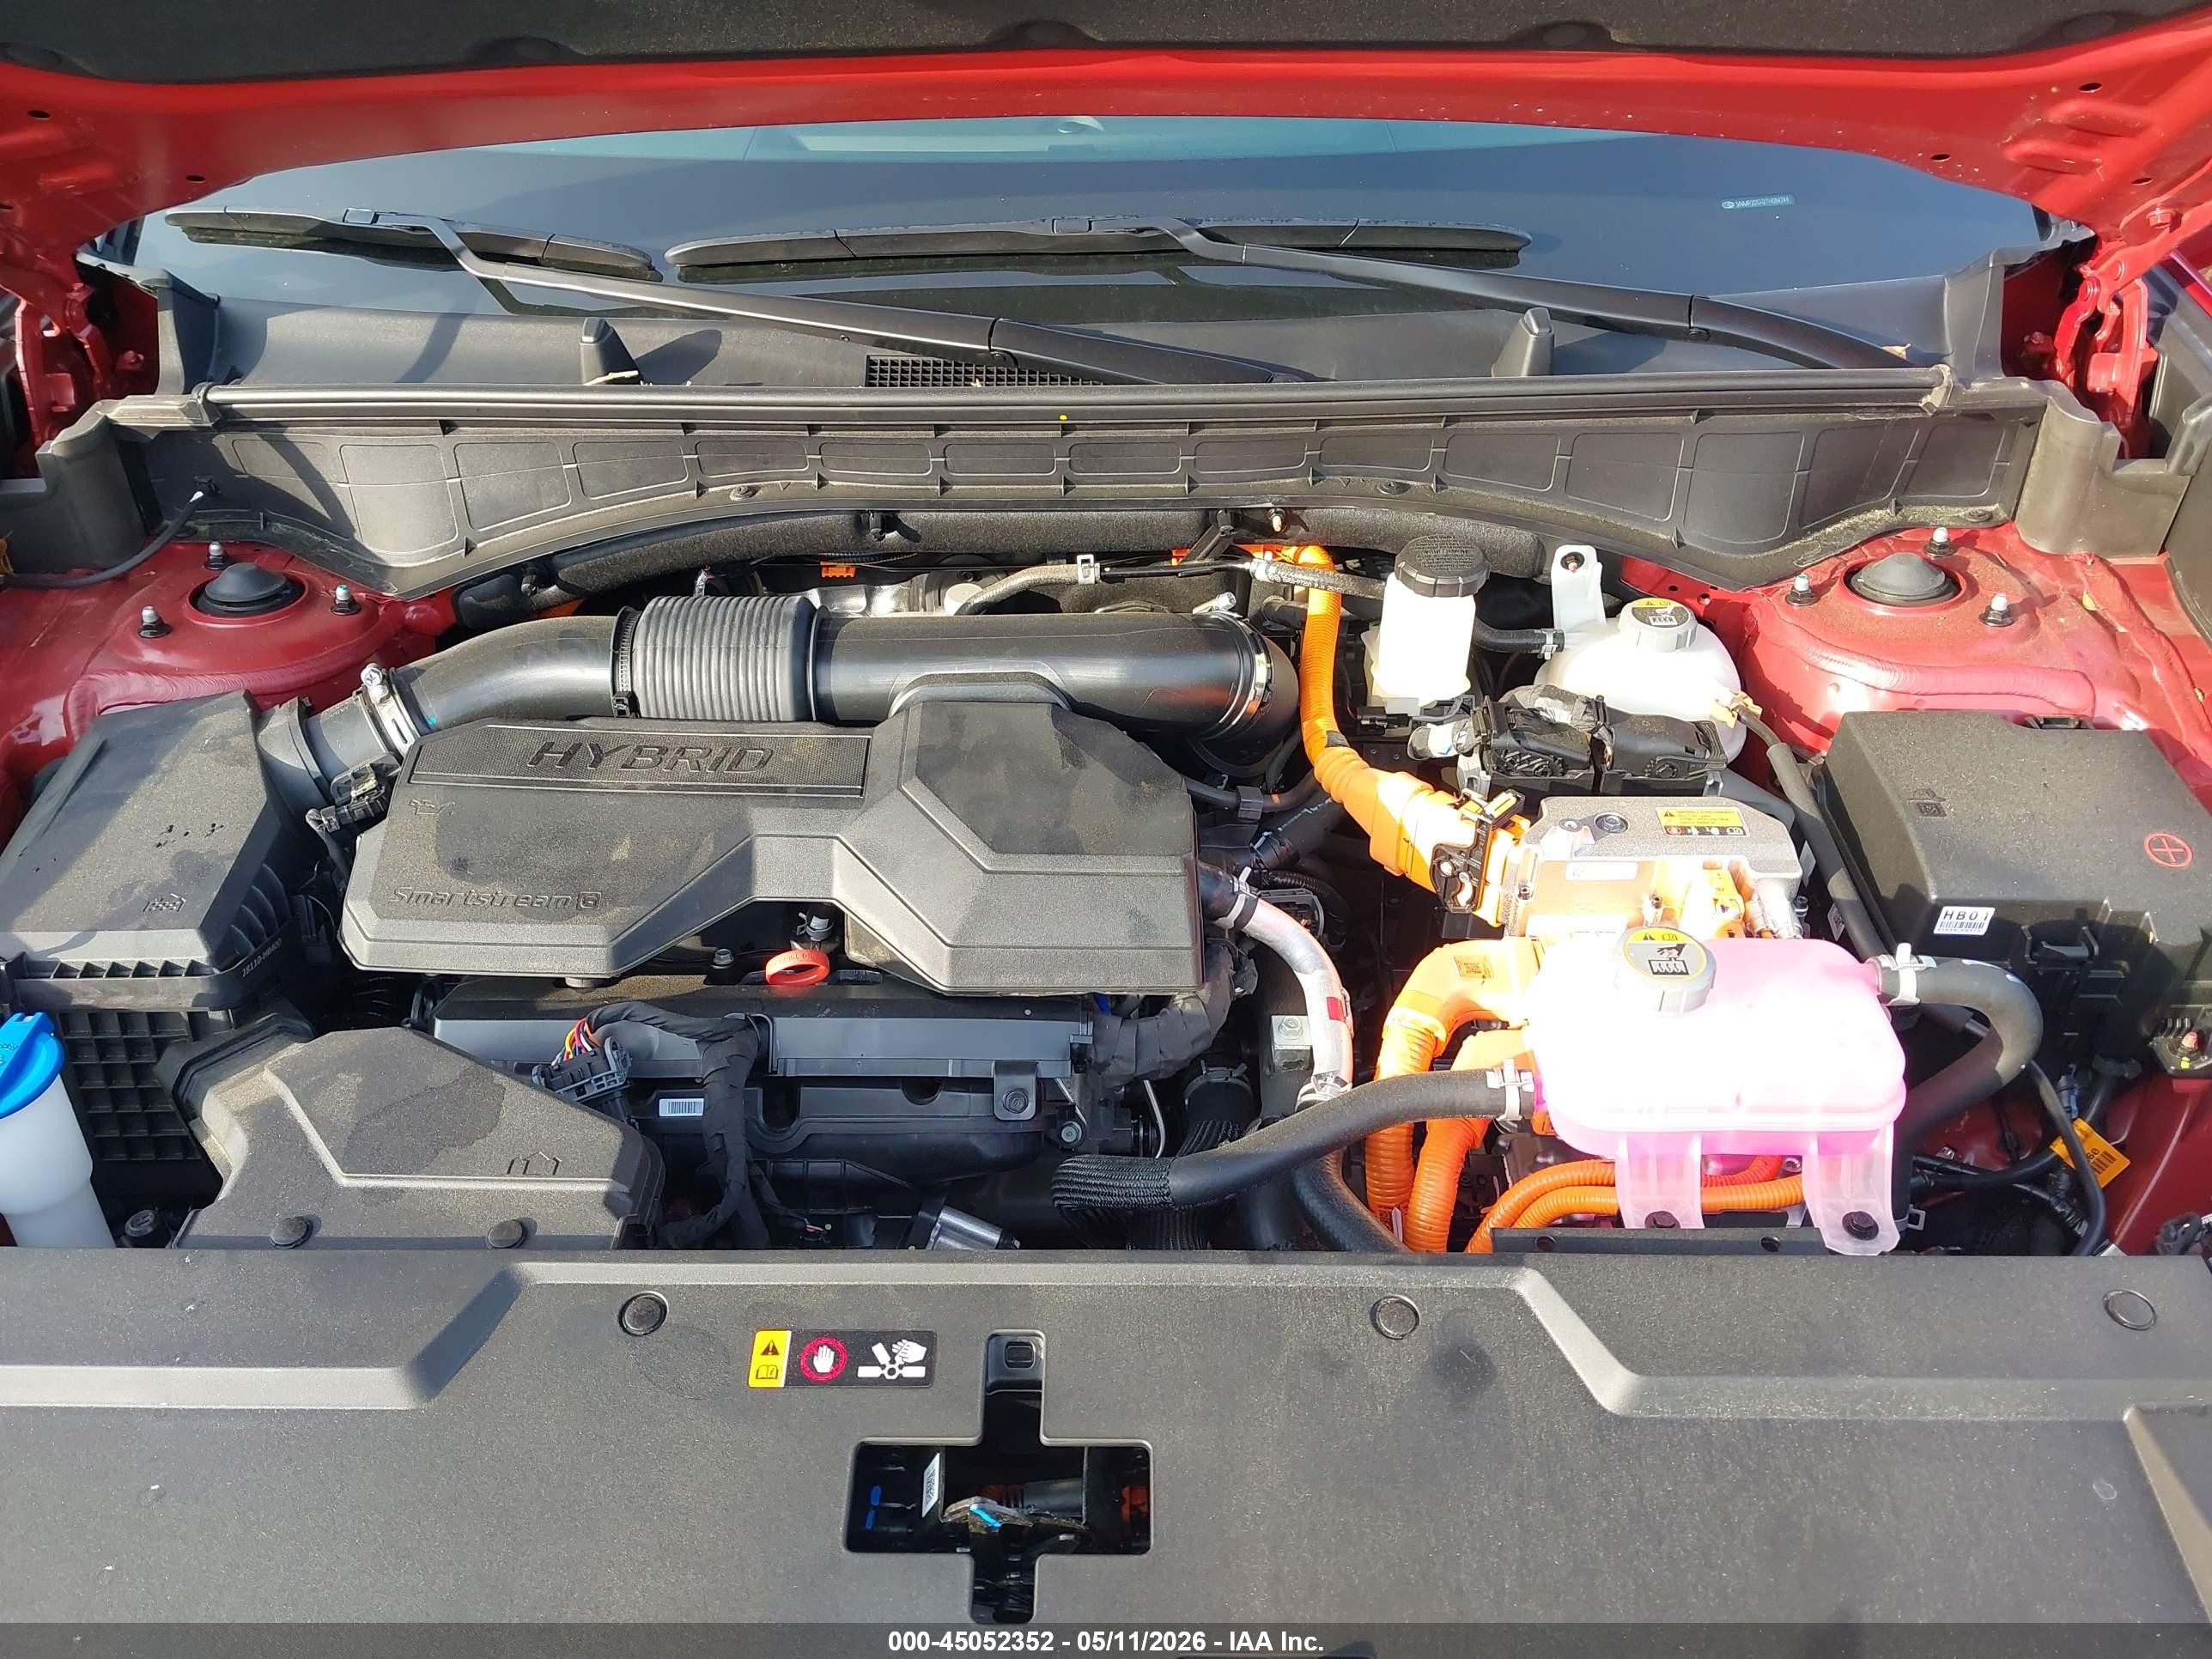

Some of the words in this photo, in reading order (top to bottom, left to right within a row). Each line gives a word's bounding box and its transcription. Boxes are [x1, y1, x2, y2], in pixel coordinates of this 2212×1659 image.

[527, 740, 774, 774] HYBRID
[388, 886, 573, 908] Smartstream
[1943, 910, 1990, 921] HB01
